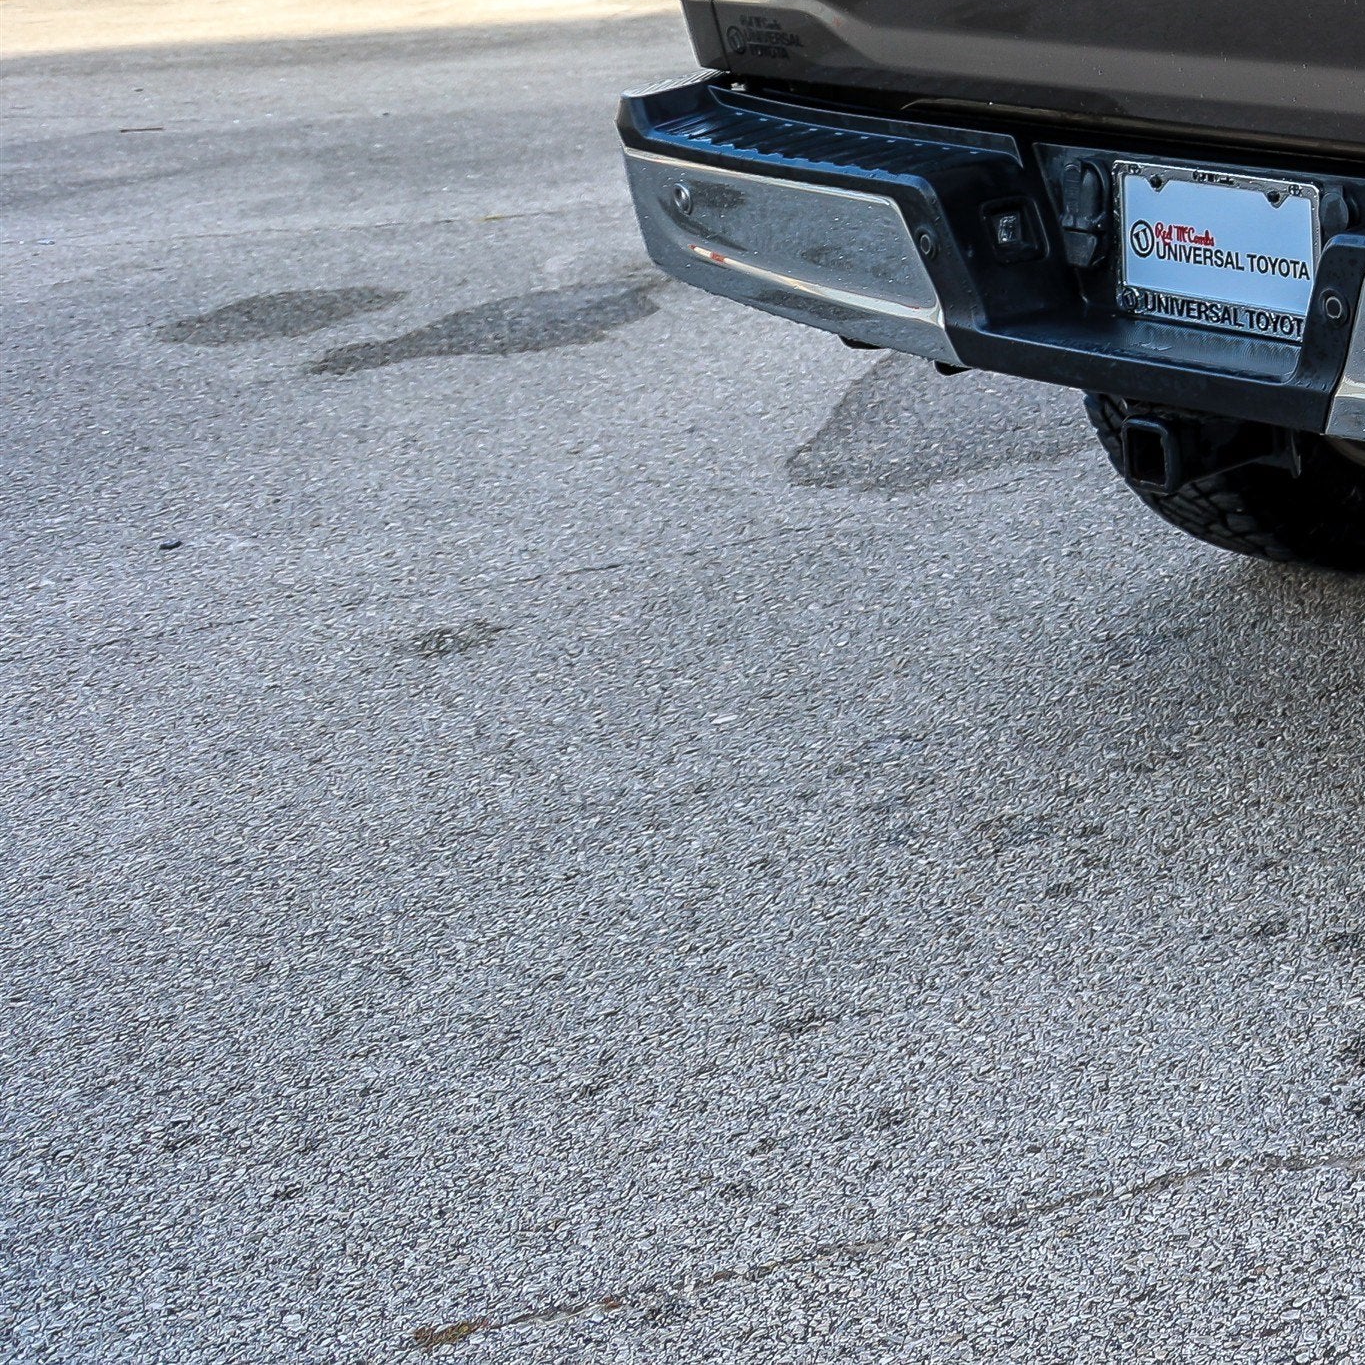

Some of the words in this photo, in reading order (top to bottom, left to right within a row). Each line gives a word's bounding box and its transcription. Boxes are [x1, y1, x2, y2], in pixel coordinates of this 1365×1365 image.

[1156, 241, 1244, 271] UNIVERSAL
[1247, 253, 1310, 281] TOYOTA
[1144, 292, 1244, 328] UNIVERSAL
[1245, 309, 1305, 337] TOYOT
